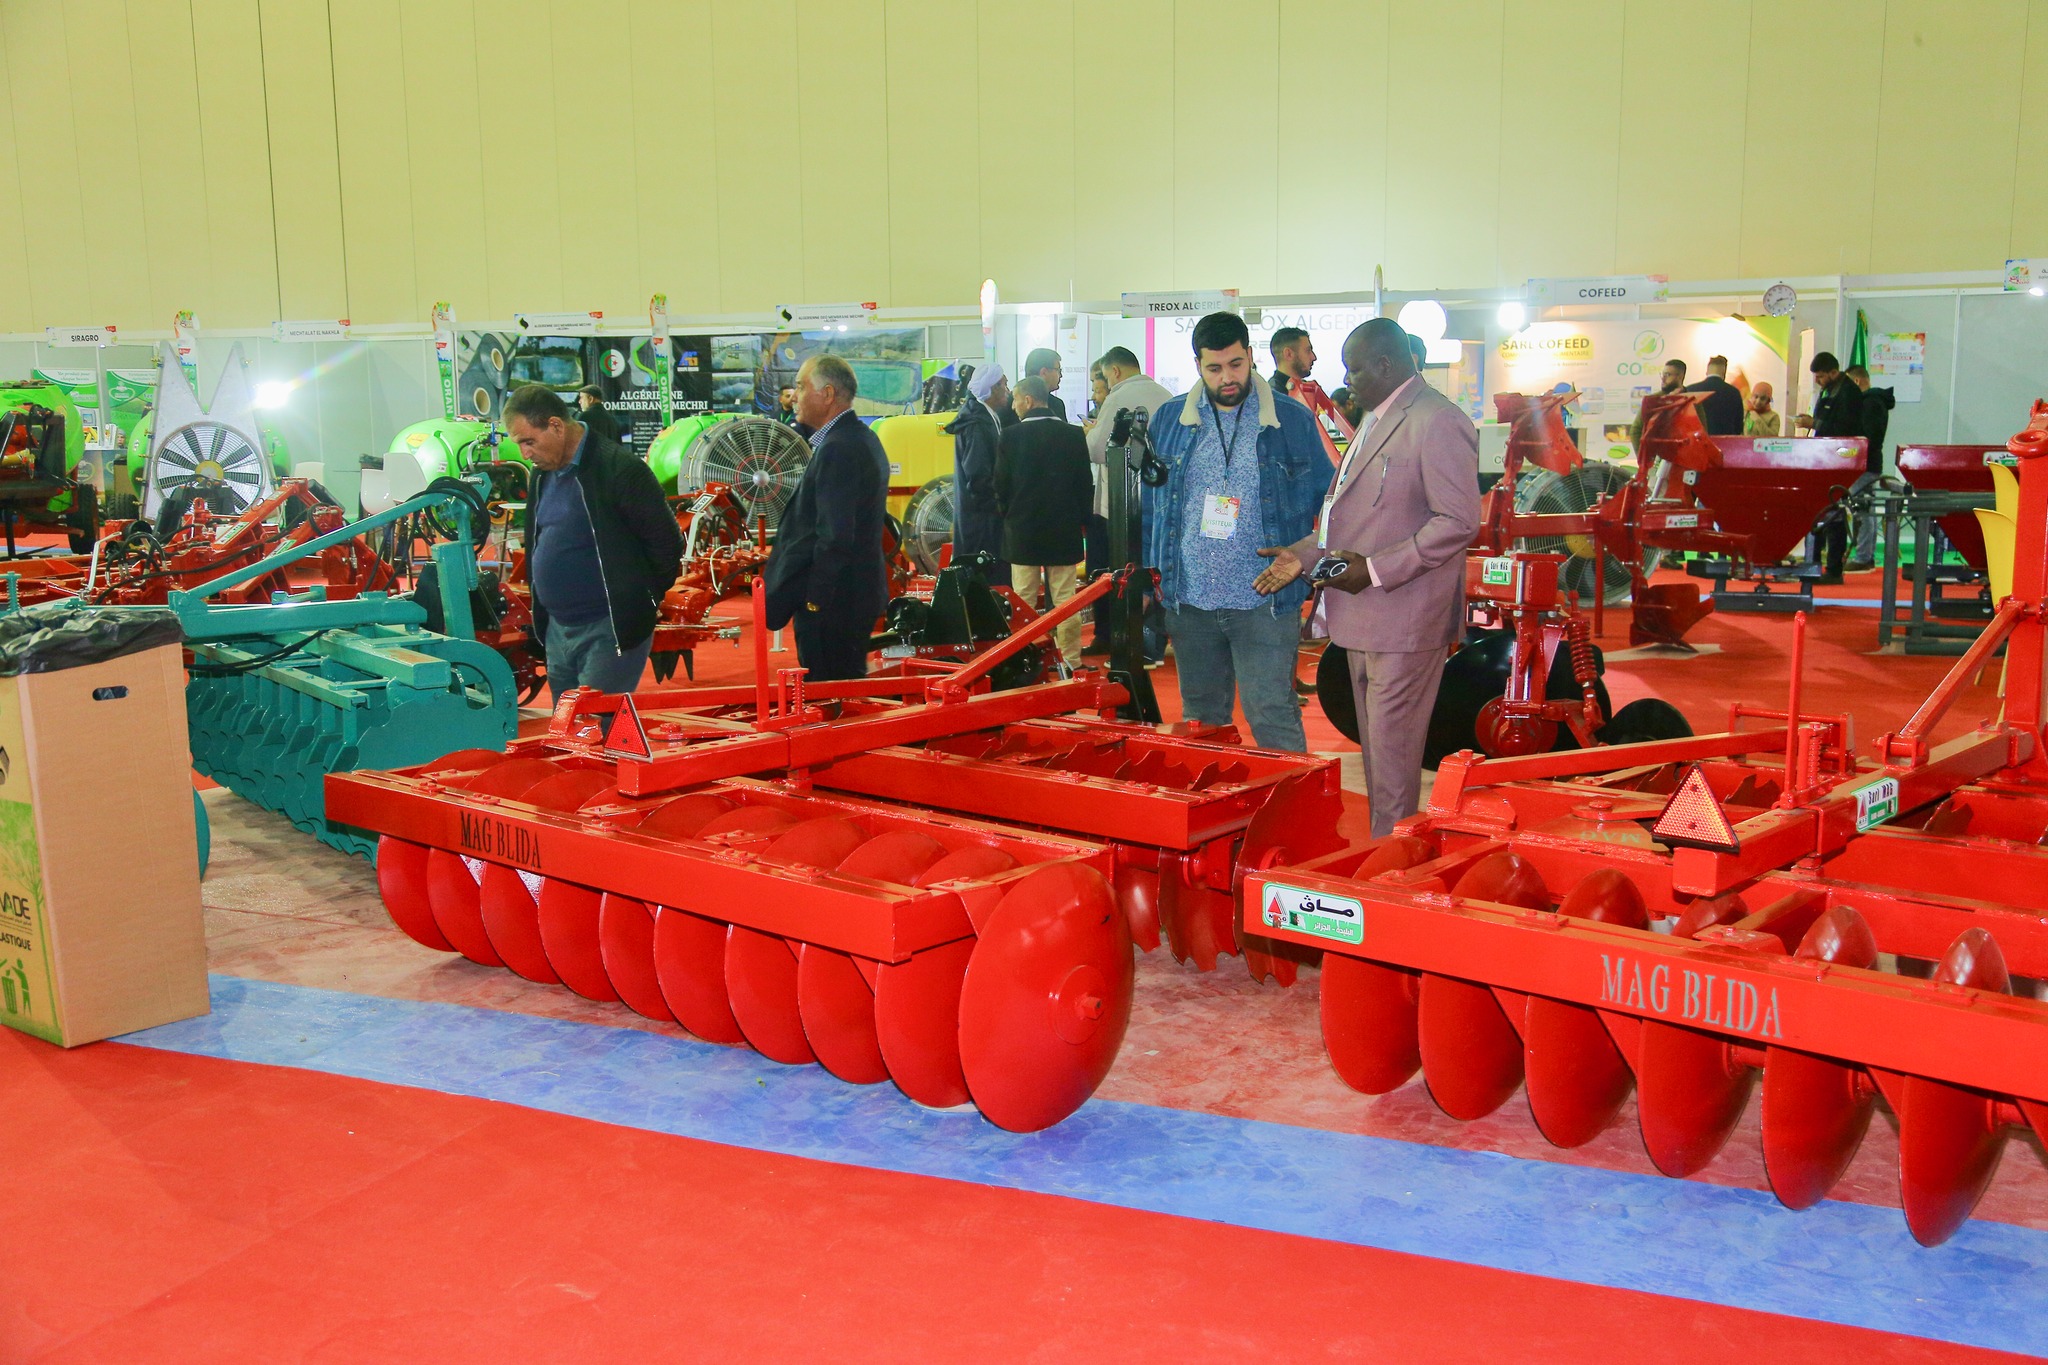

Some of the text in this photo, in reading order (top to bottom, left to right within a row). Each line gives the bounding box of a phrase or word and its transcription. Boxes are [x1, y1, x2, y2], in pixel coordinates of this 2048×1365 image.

[1579, 288, 1626, 298] COFEED
[1149, 303, 1180, 312] TREOX
[1182, 301, 1221, 311] ALGERIE
[1539, 337, 1590, 349] COFEED
[443, 379, 454, 414] ORAN
[620, 389, 682, 400] ALGÉRIENE
[660, 376, 669, 413] ORAN
[1205, 519, 1233, 527] VISITEUR
[460, 810, 541, 869] MAG BLIDA
[1600, 954, 1783, 1039] MAG BLIDA
